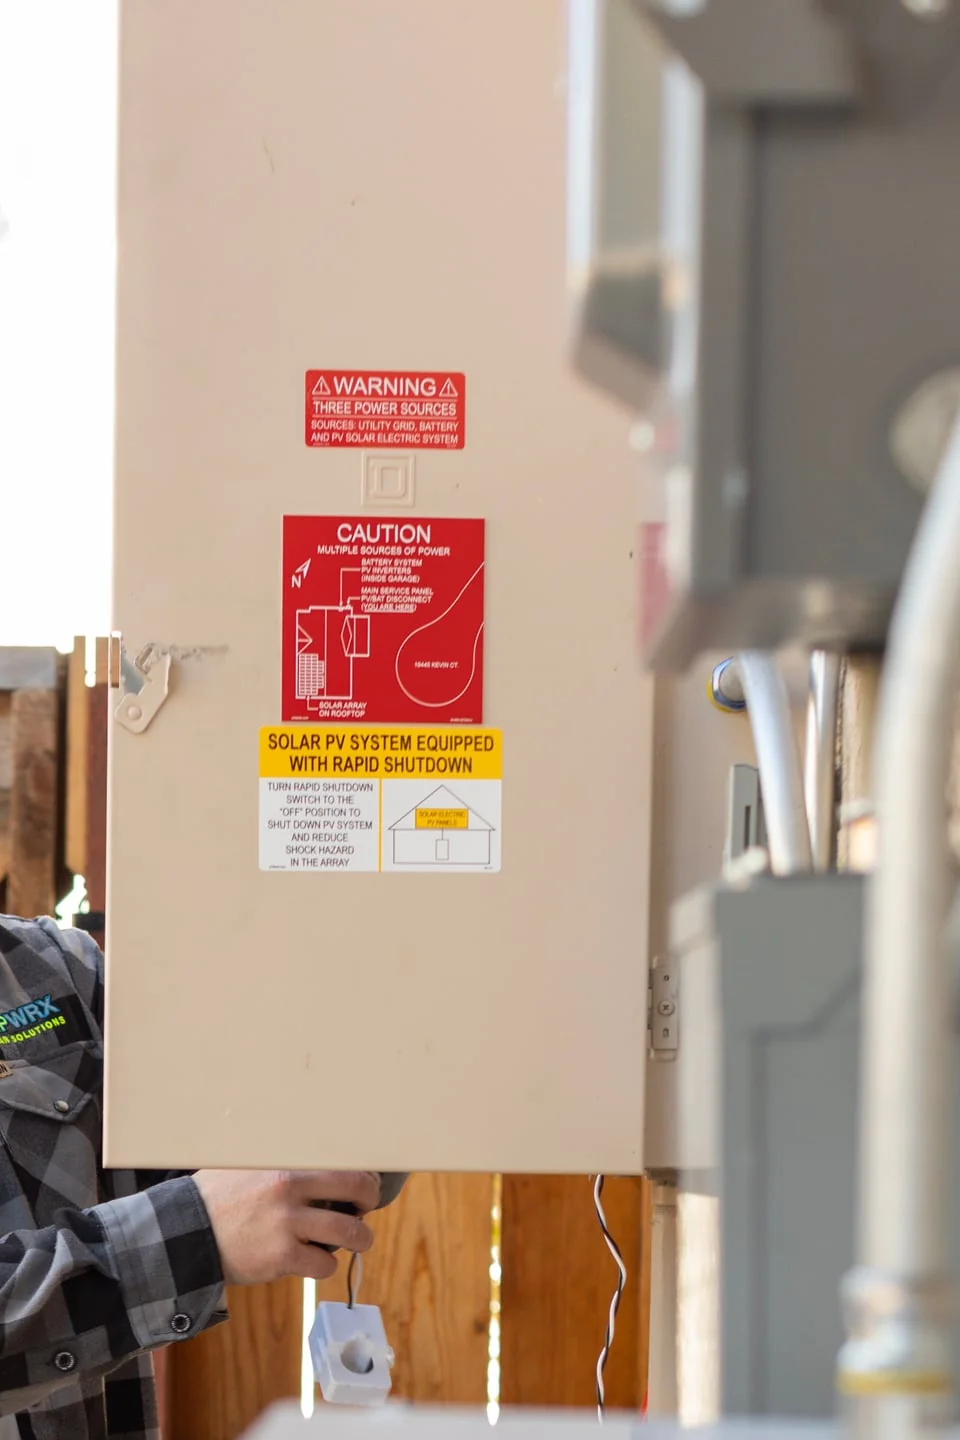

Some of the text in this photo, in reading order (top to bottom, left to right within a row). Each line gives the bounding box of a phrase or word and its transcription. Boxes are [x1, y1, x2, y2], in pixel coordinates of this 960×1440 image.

[333, 376, 437, 397] WARNING
[313, 401, 456, 416] THREE POWER SOURCES
[311, 419, 458, 432] SOURCES: UTILITY GRID, BATTERY
[311, 432, 458, 444] AND PV SOLAR ELECTRIC SYSTEM
[337, 523, 431, 544] CAUTION
[317, 545, 450, 556] MULTIPLE SOURCES OF POWER
[361, 558, 422, 567] BATTERY SYSTEM
[372, 567, 412, 575] INVERTERS
[291, 575, 302, 588] N
[361, 575, 420, 584] (INSIDE GARAGE)
[361, 587, 434, 596] MAIN SERVICE PANEL
[386, 596, 431, 604] DISCONNECT
[318, 701, 367, 710] SOLAR ARRAY
[318, 709, 365, 718] ON ROOFTOP
[268, 733, 494, 752] SOLAR PV SYSTEM EQUIPPED
[289, 756, 473, 773] WITH RAPID SHUTDOWN
[268, 782, 373, 792] TURN RAPID SHUTDOWN
[286, 795, 354, 805] SWITCH TO THE
[305, 807, 347, 817] POSITION
[348, 808, 361, 817] TO
[268, 820, 373, 830] SHUT DOWN PV SYSTEM
[291, 833, 348, 842] AND REDUCE
[285, 845, 354, 855] SHOCK HAZARD
[290, 858, 350, 868] IN THE ARRAY
[10, 1015, 66, 1044] SOLUTIONS
